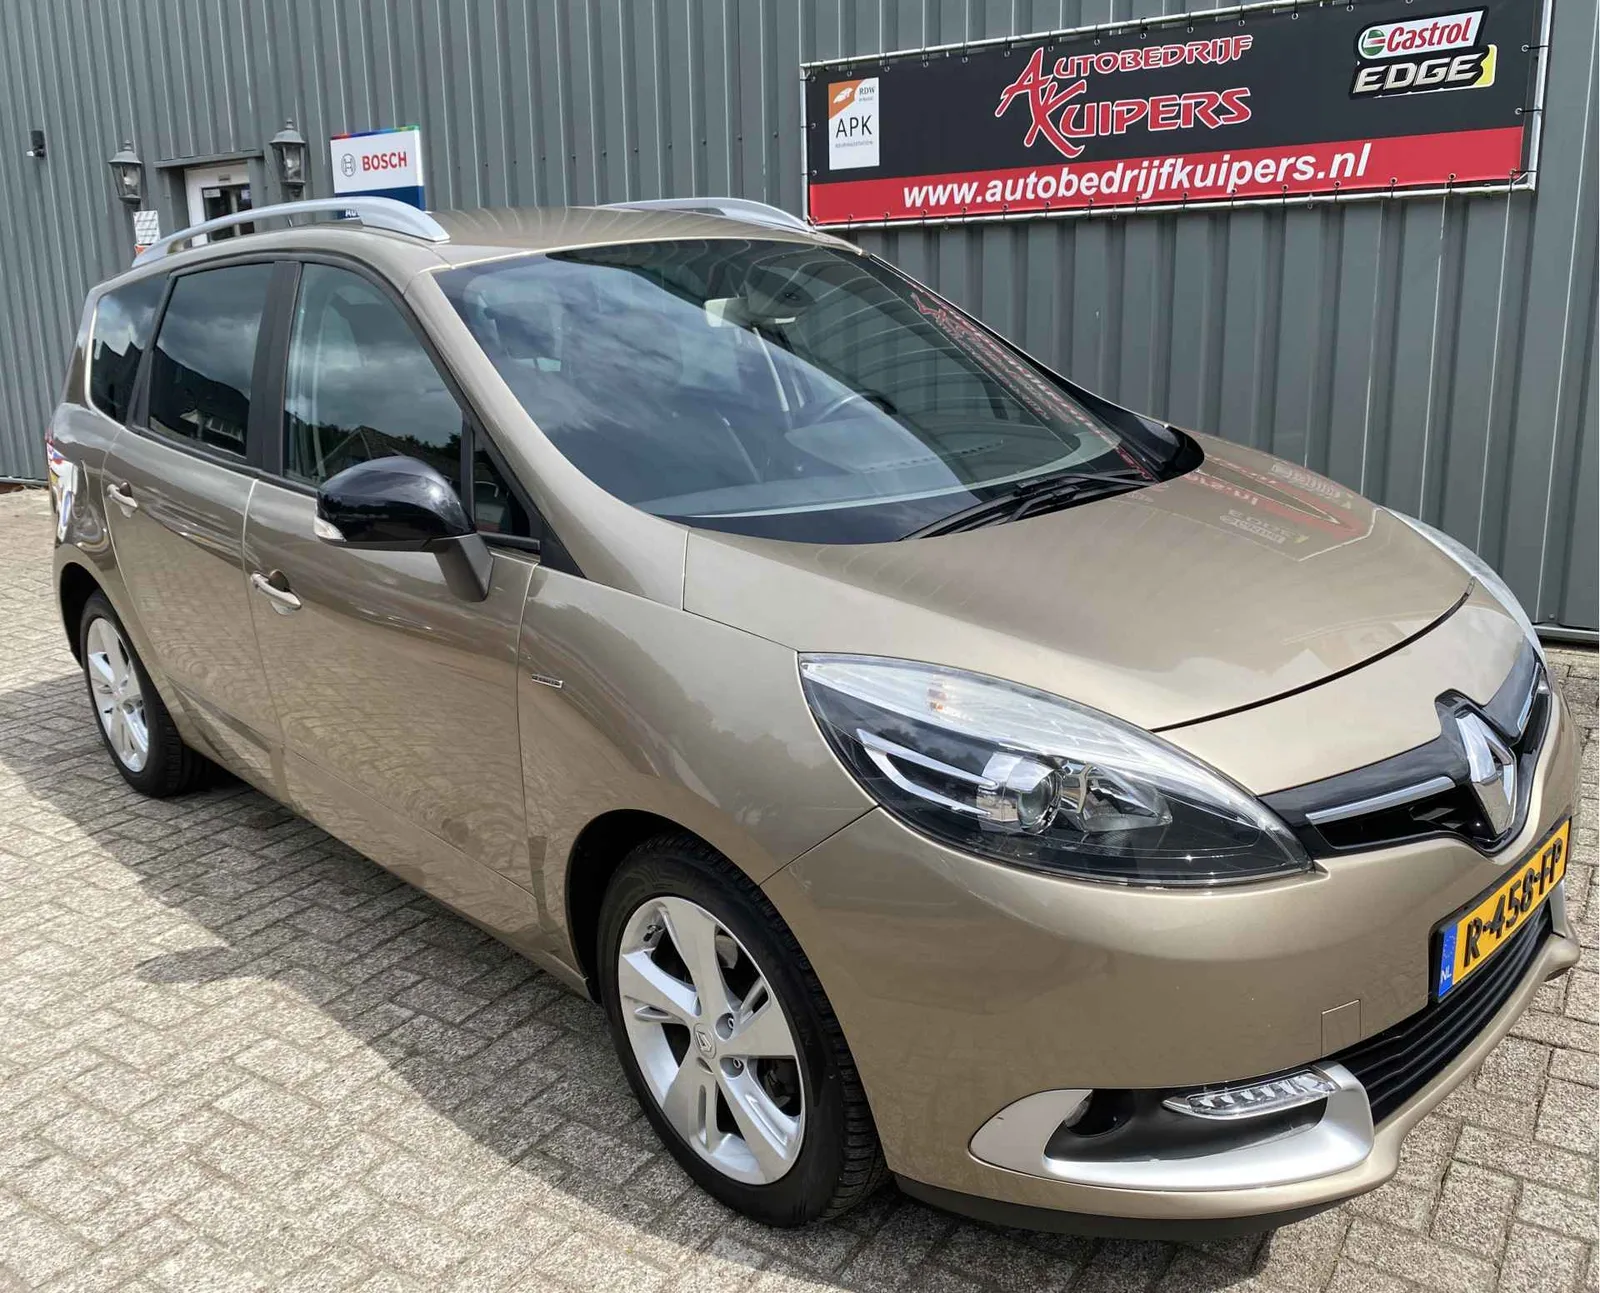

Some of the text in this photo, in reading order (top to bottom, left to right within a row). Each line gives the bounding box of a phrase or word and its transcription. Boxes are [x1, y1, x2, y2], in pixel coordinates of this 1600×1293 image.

[1387, 16, 1473, 54] Castrol
[1353, 53, 1484, 95] EDGE
[859, 86, 875, 96] RDW
[835, 115, 872, 139] APK
[362, 151, 408, 172] BOSCH
[903, 142, 1372, 208] www.autobedrijfkuipers.nl
[1463, 837, 1563, 968] R-458-FP
[1440, 965, 1453, 983] NL
